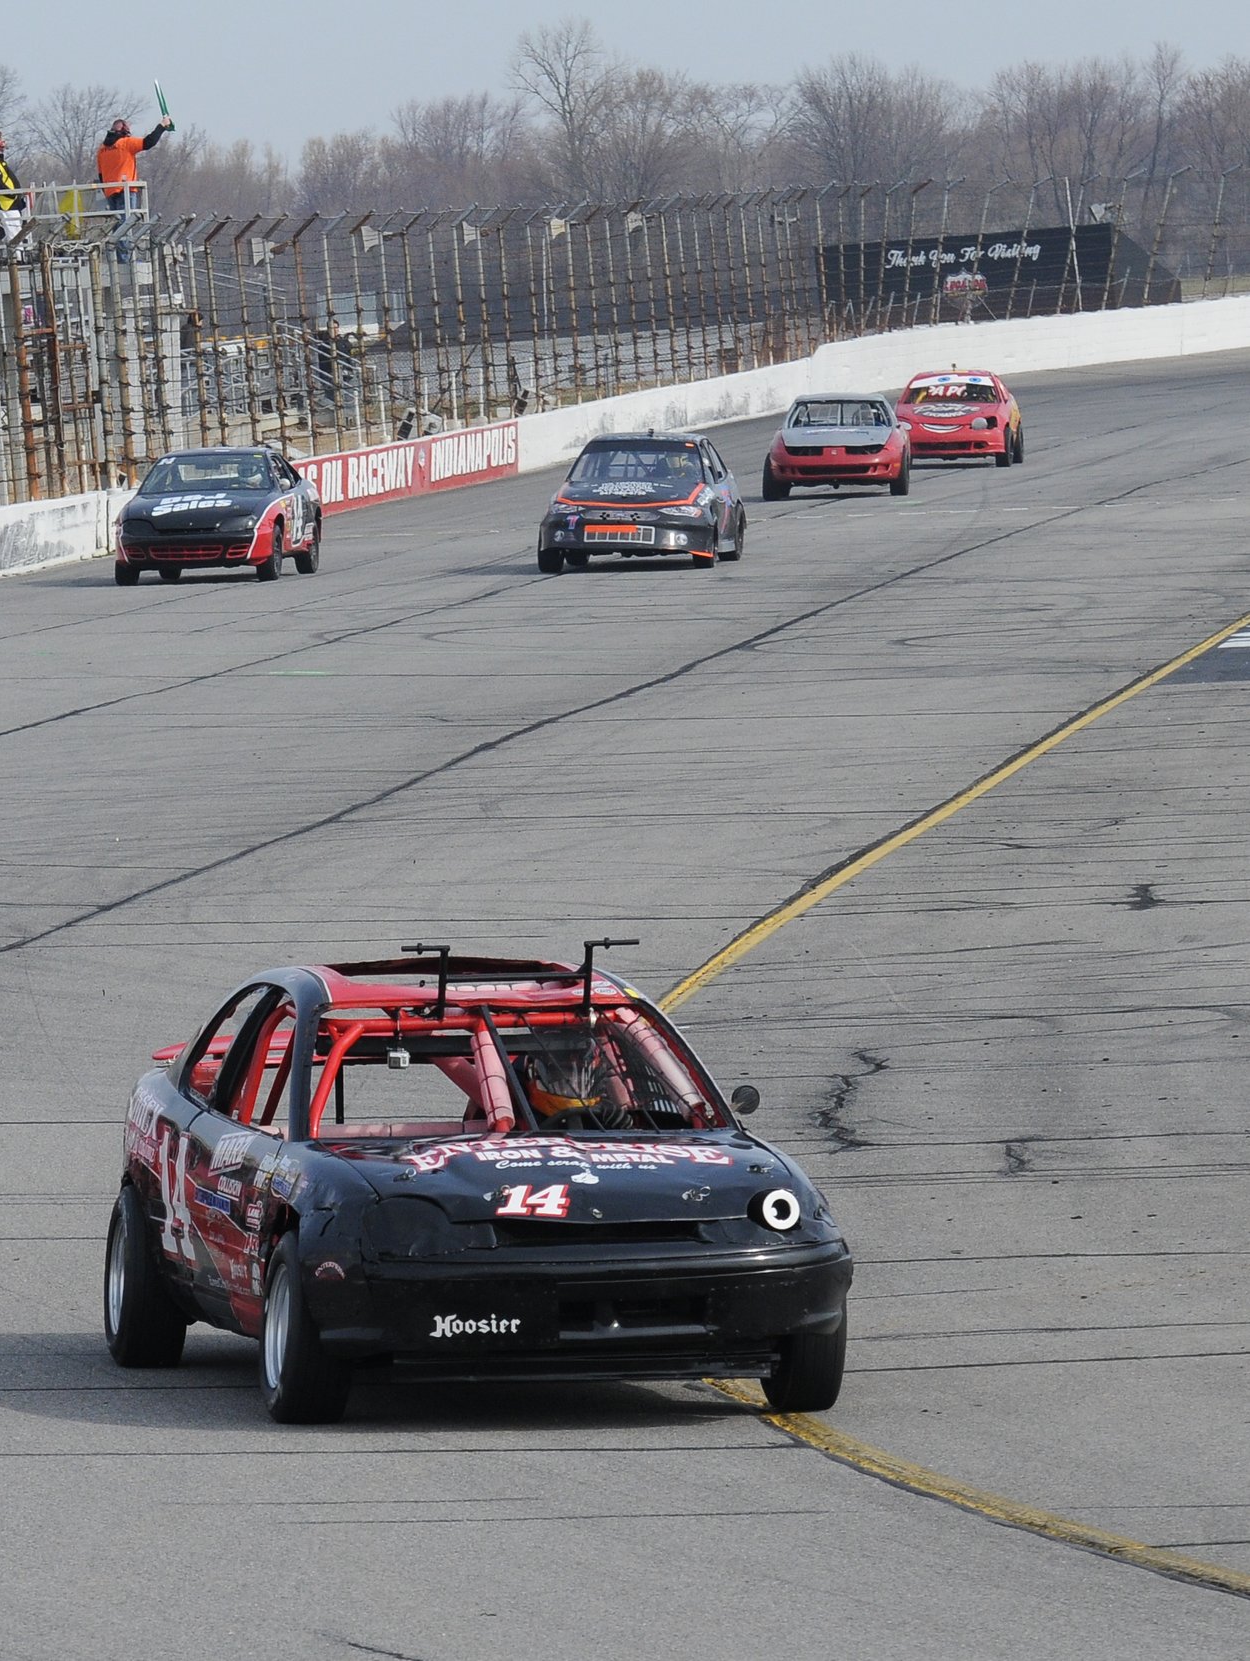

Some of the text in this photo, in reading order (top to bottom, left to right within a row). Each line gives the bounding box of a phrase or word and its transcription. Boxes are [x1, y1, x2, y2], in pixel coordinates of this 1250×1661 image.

[885, 243, 1041, 268] Thank You For Visiting
[321, 460, 344, 505] OIL
[348, 446, 414, 499] RACEWAY
[431, 426, 516, 482] INDIANAPOLIS
[151, 500, 233, 517] Sales
[406, 1136, 733, 1171] ENTERPRISE
[477, 1147, 675, 1165] IRON & METAL
[495, 1159, 658, 1170] Come scrap with us
[159, 1126, 198, 1267] 14
[496, 1184, 569, 1218] 14
[430, 1313, 521, 1338] Hoosier
